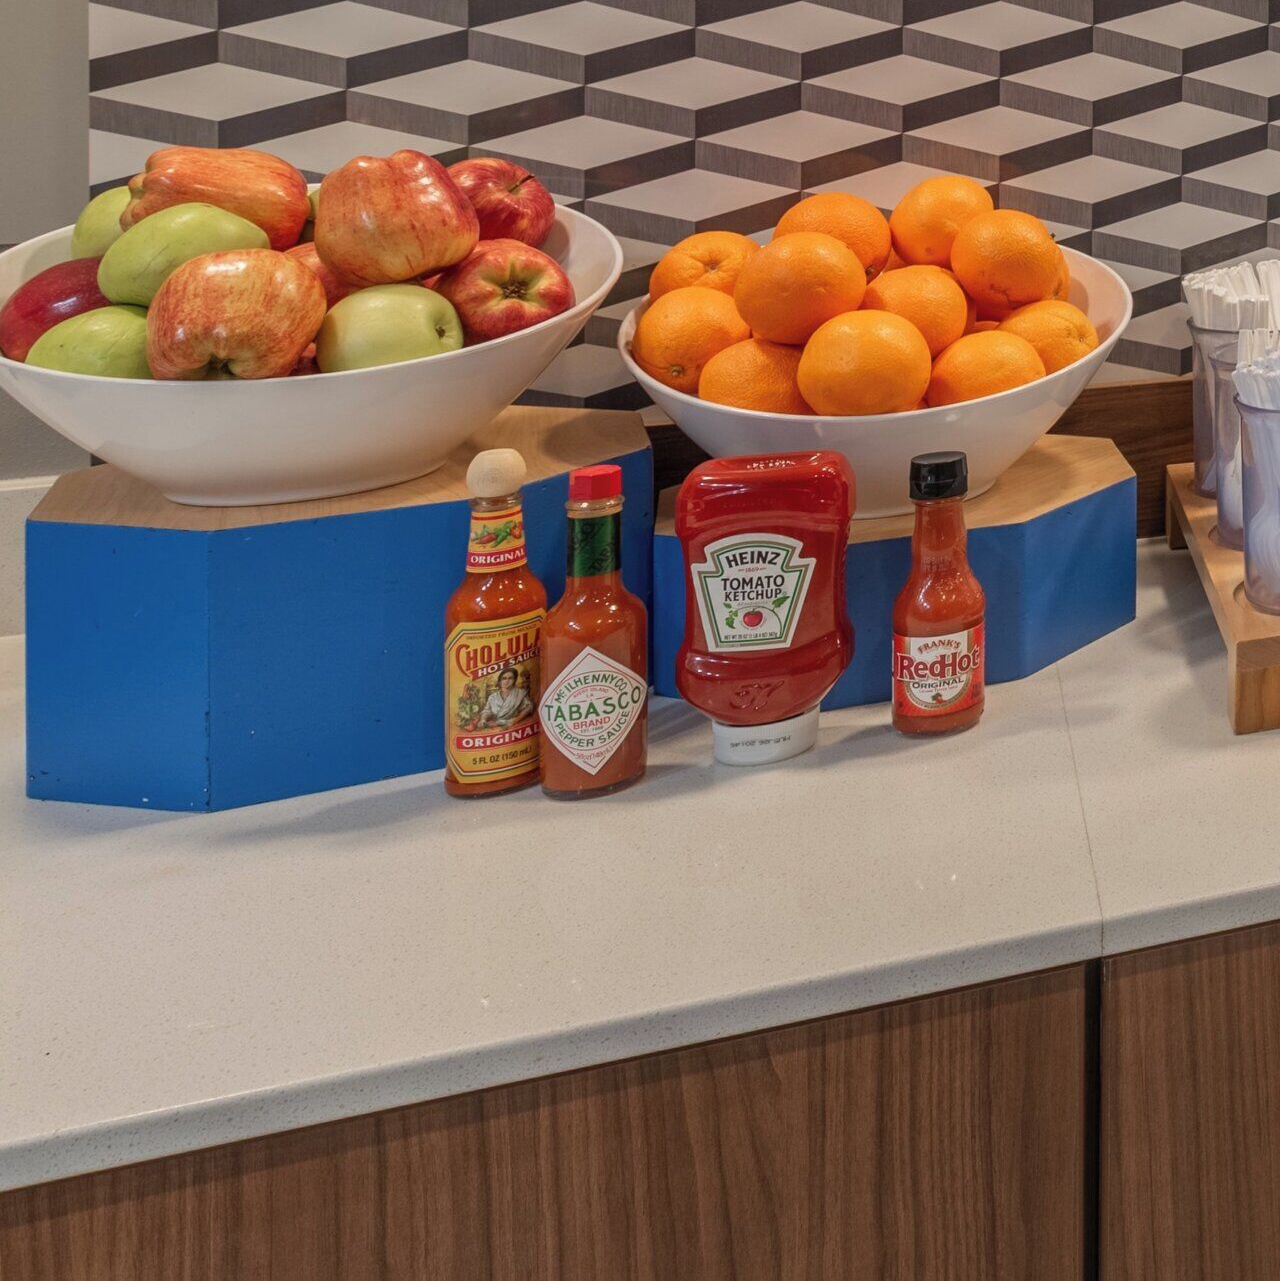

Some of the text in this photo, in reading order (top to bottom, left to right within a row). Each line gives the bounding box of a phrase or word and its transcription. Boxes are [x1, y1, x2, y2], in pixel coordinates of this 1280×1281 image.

[470, 548, 524, 564] ORIGINAL
[725, 550, 781, 569] HEINZ
[721, 574, 785, 591] TOMATO
[724, 588, 782, 602] KETCHUP
[917, 639, 961, 654] FRANK'S
[478, 662, 505, 678] HOT
[898, 646, 980, 680] RedHot
[912, 677, 964, 689] ORIGINAL
[544, 686, 641, 722] TABASCO
[555, 710, 630, 748] PEPPER SAUCE
[572, 716, 611, 730] BRAND
[462, 723, 541, 748] ORIGINAL
[472, 757, 478, 765] 5
[478, 756, 489, 765] FL
[489, 754, 501, 764] OZ
[501, 750, 518, 761] (150
